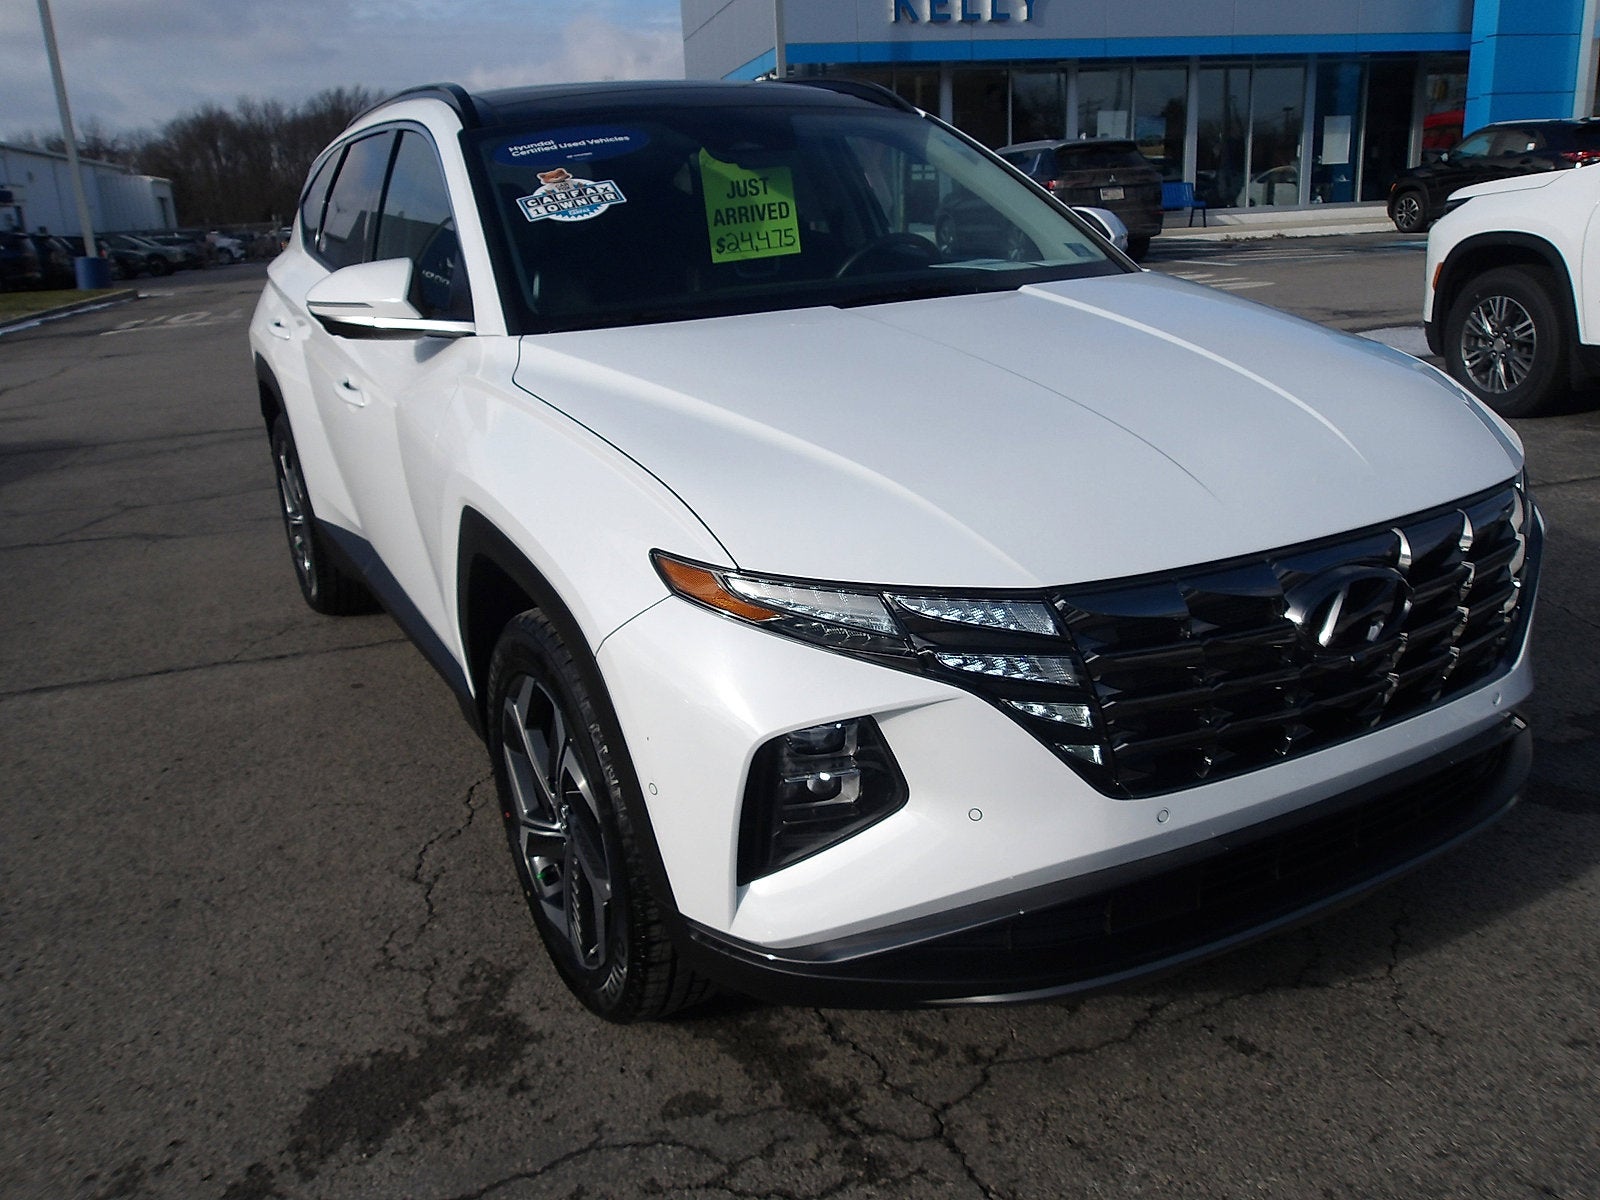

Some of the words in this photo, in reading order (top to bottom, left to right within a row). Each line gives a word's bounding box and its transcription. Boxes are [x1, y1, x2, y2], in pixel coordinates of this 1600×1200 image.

[894, 0, 1035, 22] KELLY
[508, 139, 555, 152] Hyundai
[511, 145, 558, 157] Certified
[558, 139, 586, 149] Used
[586, 135, 630, 145] Vehicles
[526, 186, 610, 207] CARFAX
[726, 177, 769, 199] JUST
[546, 193, 617, 212] OWNER
[713, 201, 790, 227] ARRIVED
[716, 228, 796, 254] $24,475
